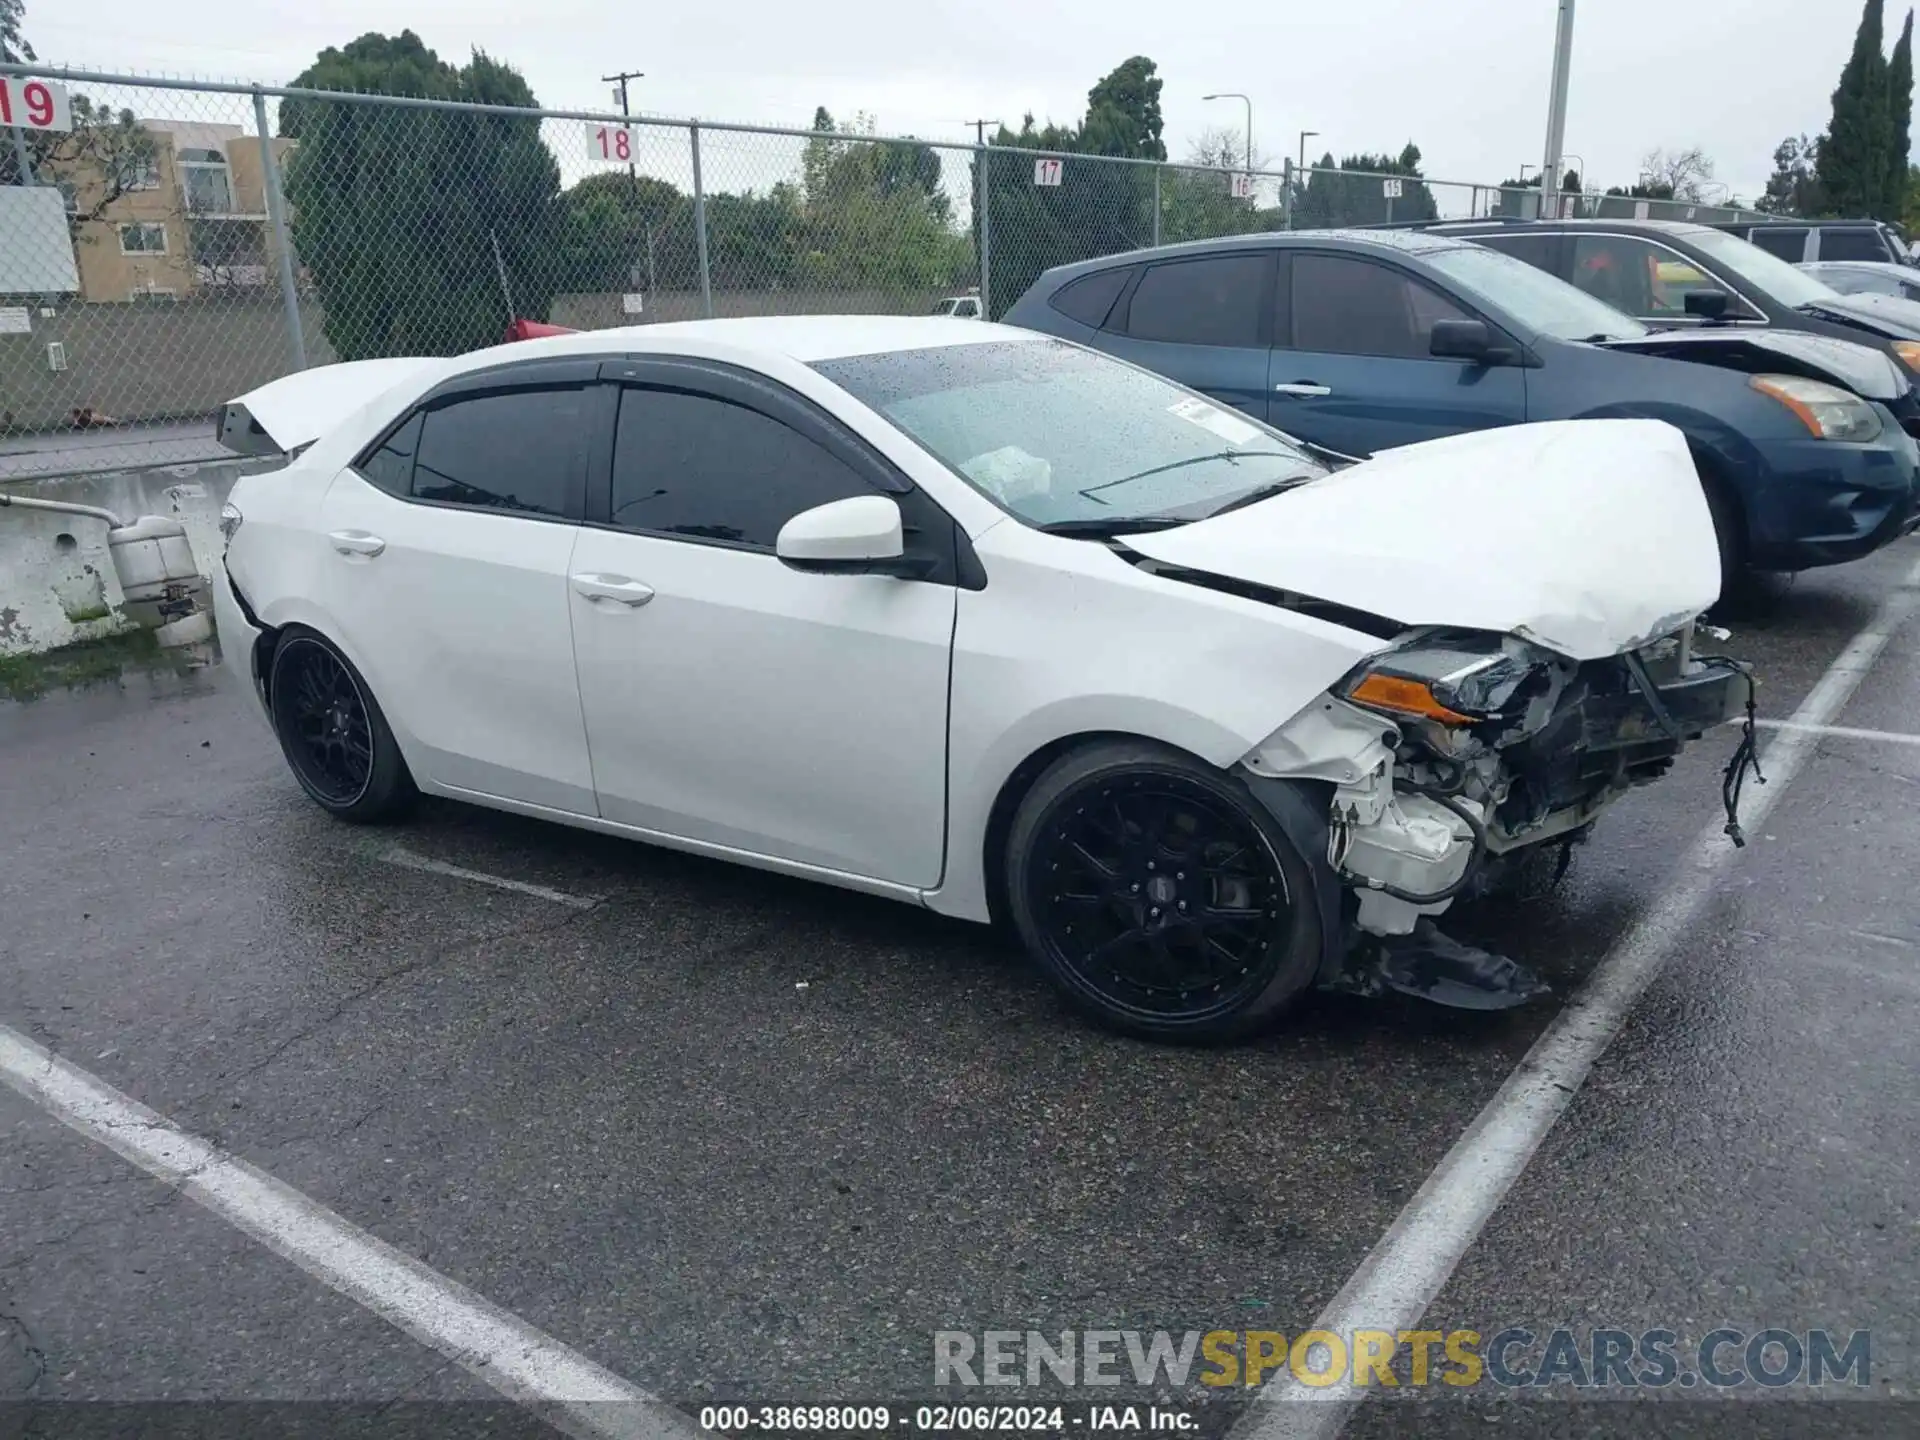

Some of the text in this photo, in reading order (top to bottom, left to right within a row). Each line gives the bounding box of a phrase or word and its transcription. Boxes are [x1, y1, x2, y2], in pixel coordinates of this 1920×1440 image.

[596, 127, 631, 161] 18
[1041, 161, 1059, 184] 17
[1237, 177, 1249, 196] 16
[1388, 180, 1400, 196] 15
